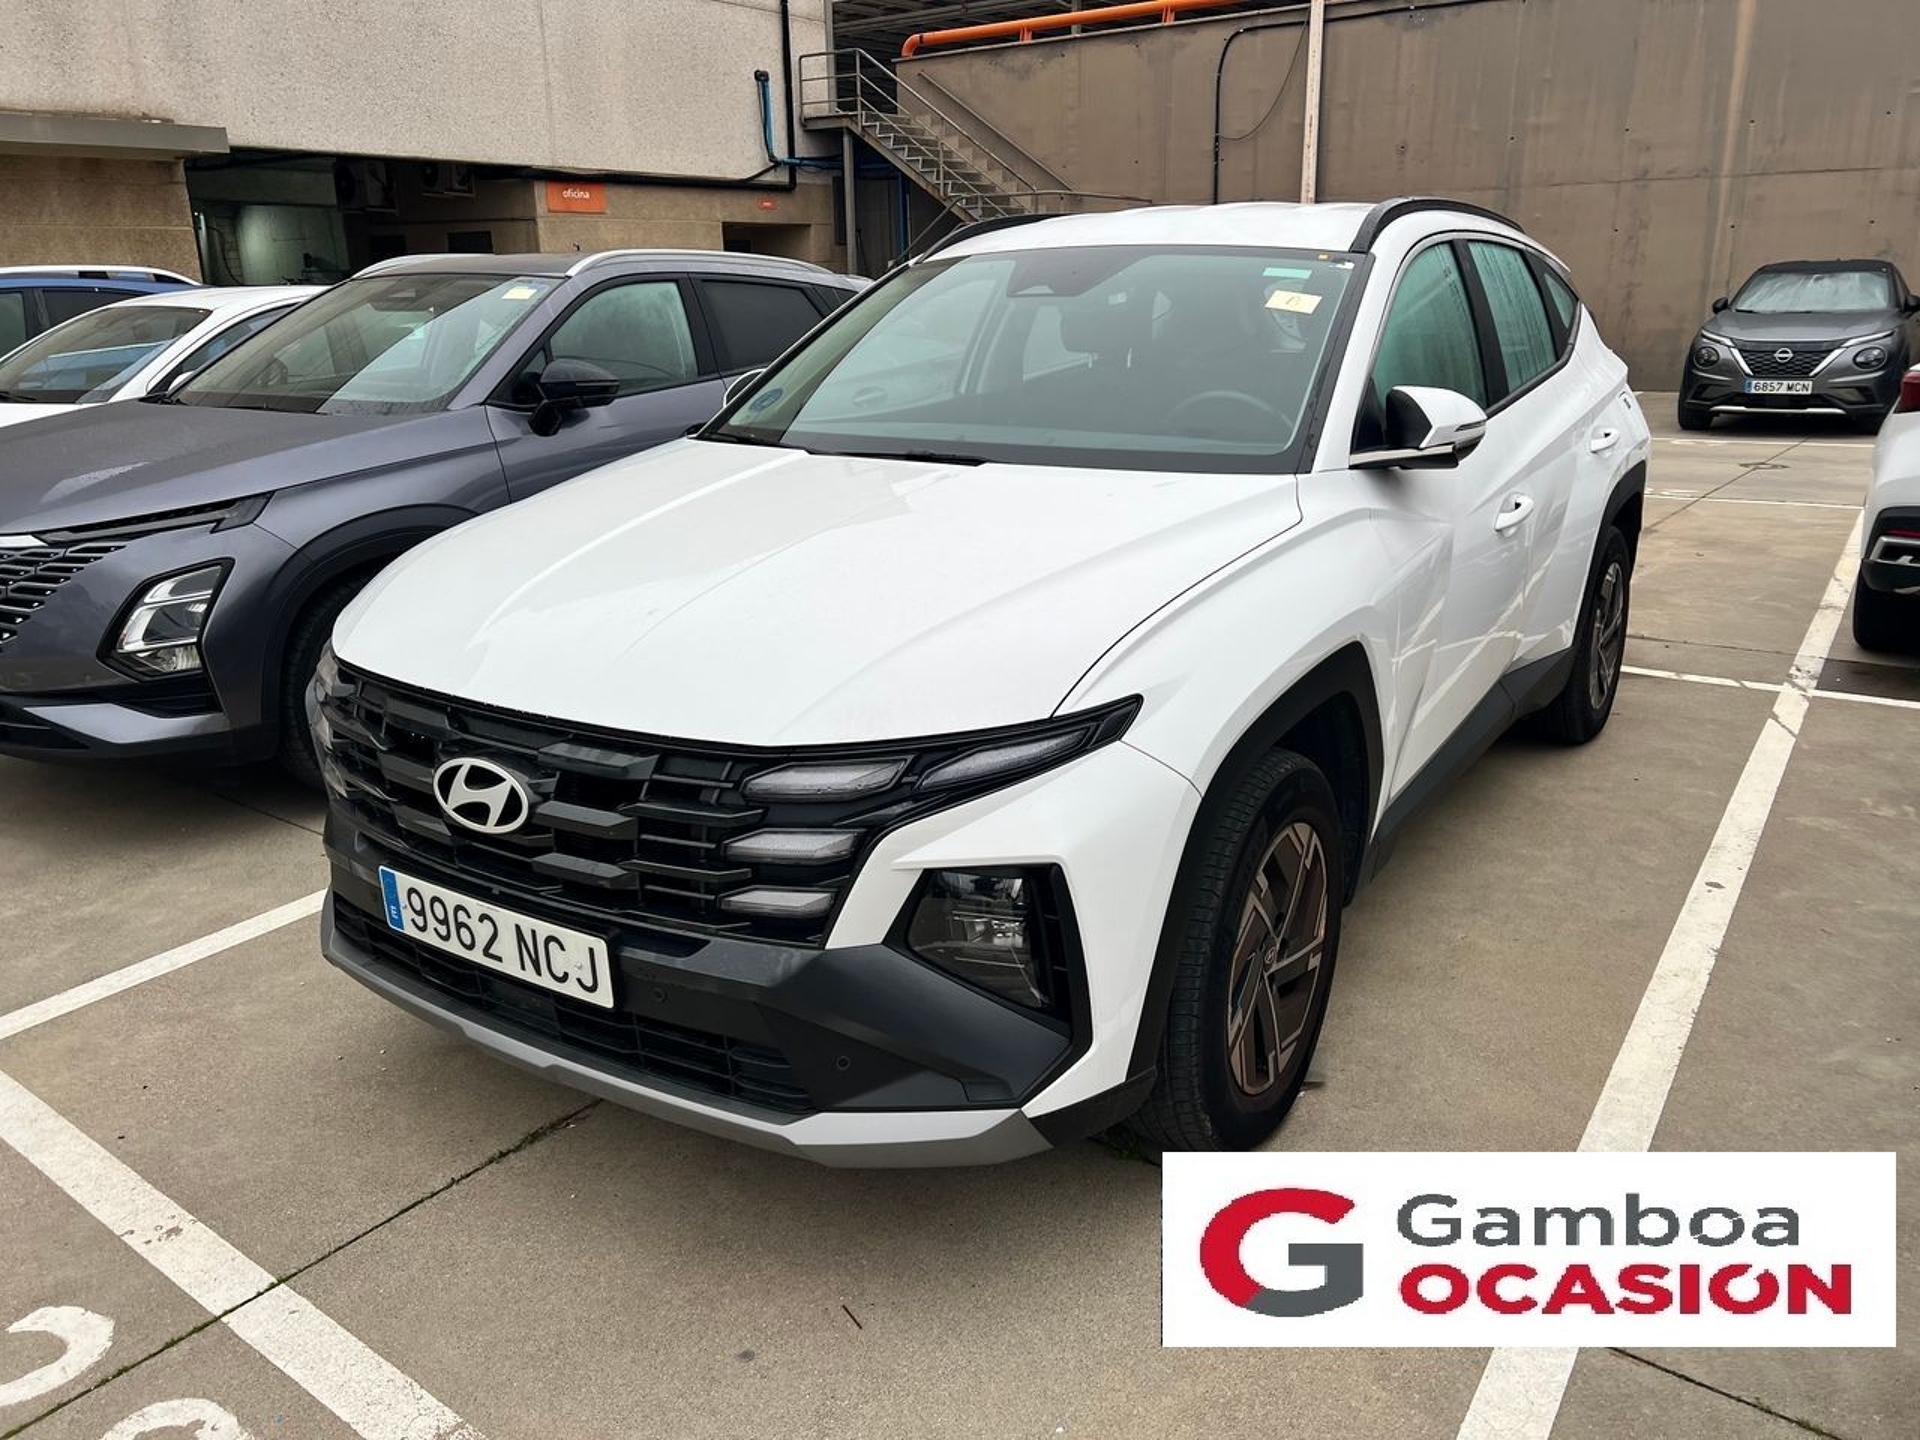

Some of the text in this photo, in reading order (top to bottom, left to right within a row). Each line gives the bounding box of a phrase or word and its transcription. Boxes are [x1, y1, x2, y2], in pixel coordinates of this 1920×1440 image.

[562, 188, 590, 199] oficina
[1754, 382, 1783, 392] 6857
[406, 887, 599, 994] 9962 NCJ
